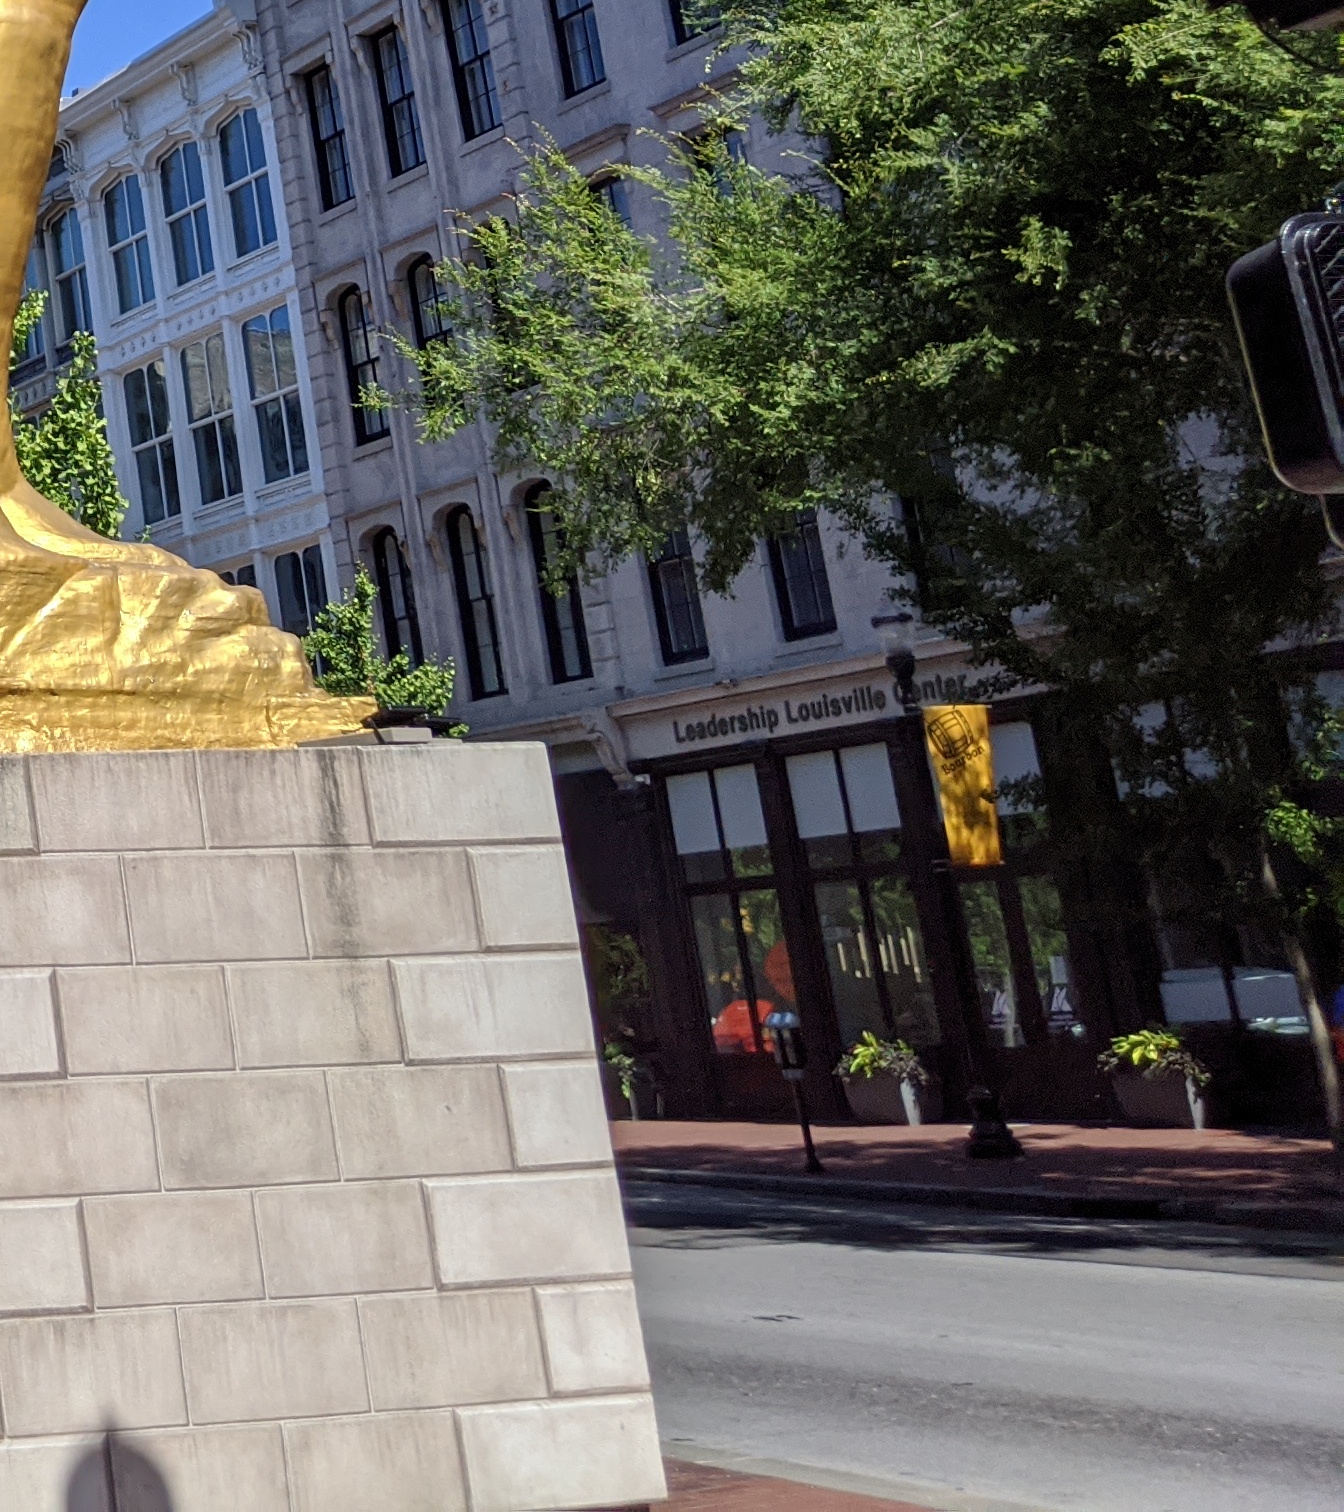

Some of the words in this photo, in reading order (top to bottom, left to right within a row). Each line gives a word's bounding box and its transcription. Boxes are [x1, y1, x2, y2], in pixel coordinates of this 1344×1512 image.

[673, 704, 779, 744] Leadership
[784, 685, 887, 725] Louisville
[941, 744, 986, 775] Bourbon
